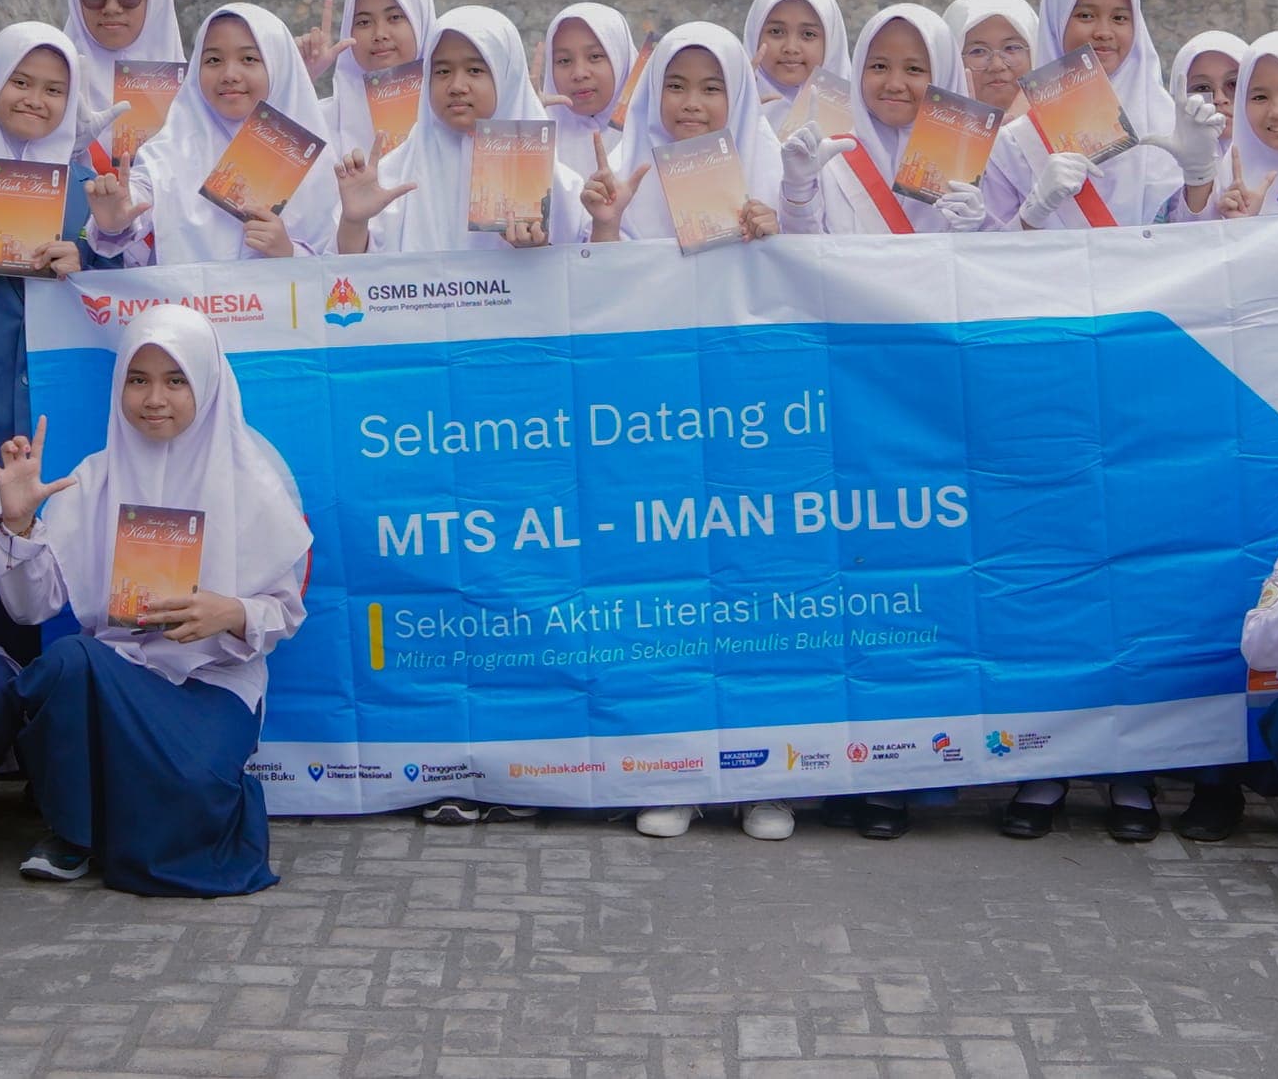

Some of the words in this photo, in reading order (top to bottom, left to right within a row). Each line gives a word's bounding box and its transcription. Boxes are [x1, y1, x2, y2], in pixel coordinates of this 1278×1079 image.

[367, 283, 418, 301] GSMB
[423, 278, 511, 298] NASIONAL
[117, 293, 263, 317] NYANESIA
[368, 303, 399, 313] Program
[400, 299, 455, 312] Pengembangan
[456, 298, 482, 307] Literasi
[484, 296, 512, 306] Sekolah
[359, 407, 572, 460] Selamat
[589, 402, 769, 449] Datang
[783, 389, 827, 434] di
[377, 508, 497, 558] MTS
[512, 505, 582, 552] AL
[597, 522, 616, 533] -
[633, 492, 776, 544] IMAN
[793, 484, 970, 535] BULUS
[394, 607, 532, 639] Sekolah
[543, 598, 623, 635] Aktif
[635, 591, 760, 629] Literasi
[772, 582, 922, 620] Nasional
[395, 651, 446, 669] Mitra
[452, 651, 535, 672] Program
[541, 646, 624, 666] Gerakan
[630, 638, 709, 660] Sekolah
[714, 633, 789, 655] Menulis
[795, 628, 844, 650] Buku
[850, 624, 938, 646] Nasional
[245, 763, 282, 771] ademisi
[422, 763, 468, 774] Penggerak
[524, 762, 605, 775] Nyalaakademi
[637, 756, 704, 771] Nyalagaleri
[270, 772, 296, 781] Buku
[423, 773, 460, 782] Literasi
